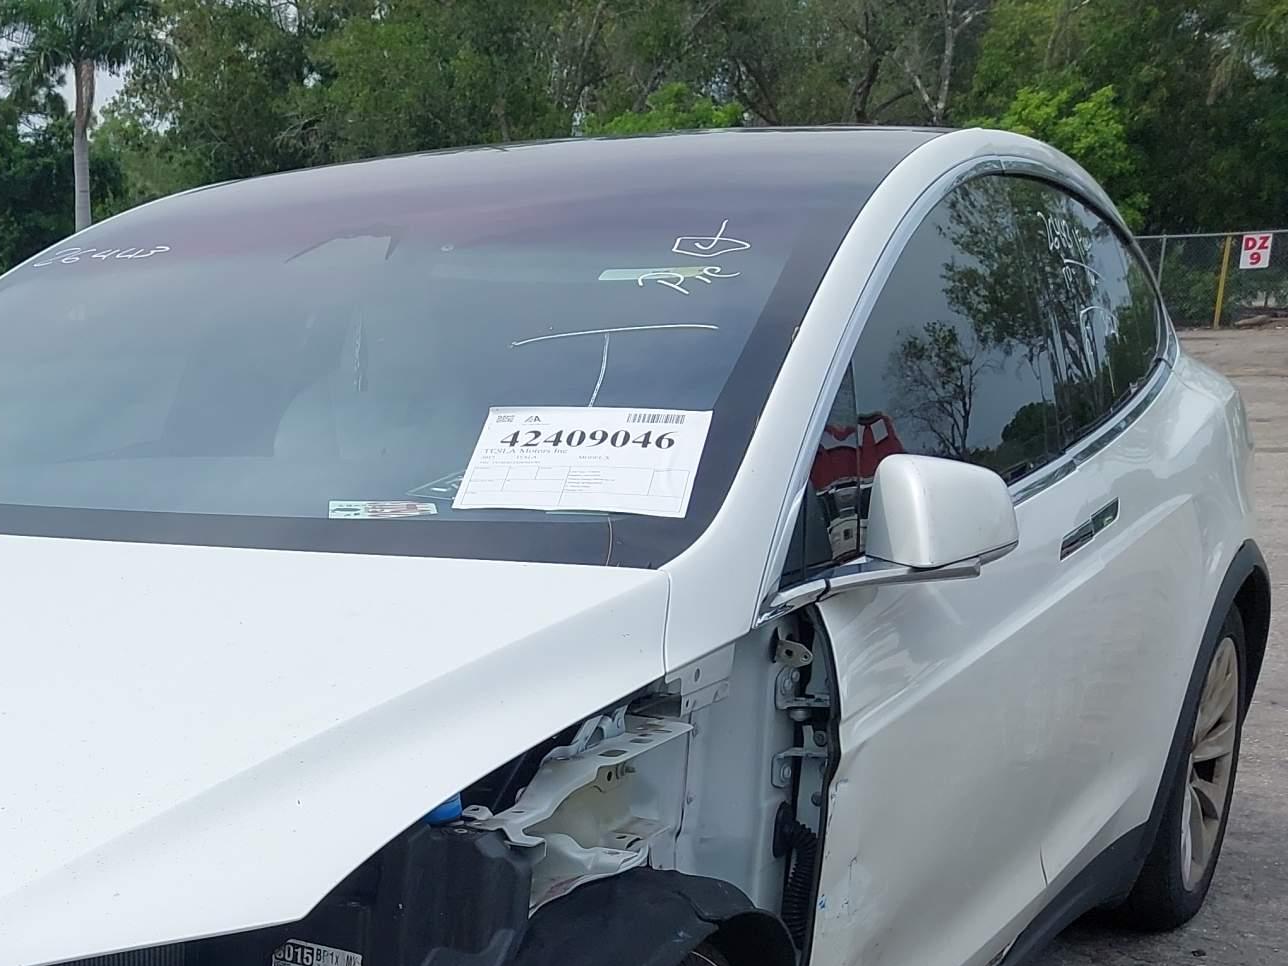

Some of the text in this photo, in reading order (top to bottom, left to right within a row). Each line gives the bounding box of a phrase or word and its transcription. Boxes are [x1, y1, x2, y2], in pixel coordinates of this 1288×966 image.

[1244, 236, 1270, 250] DZ
[1249, 252, 1261, 265] 9
[500, 430, 678, 449] 42409046
